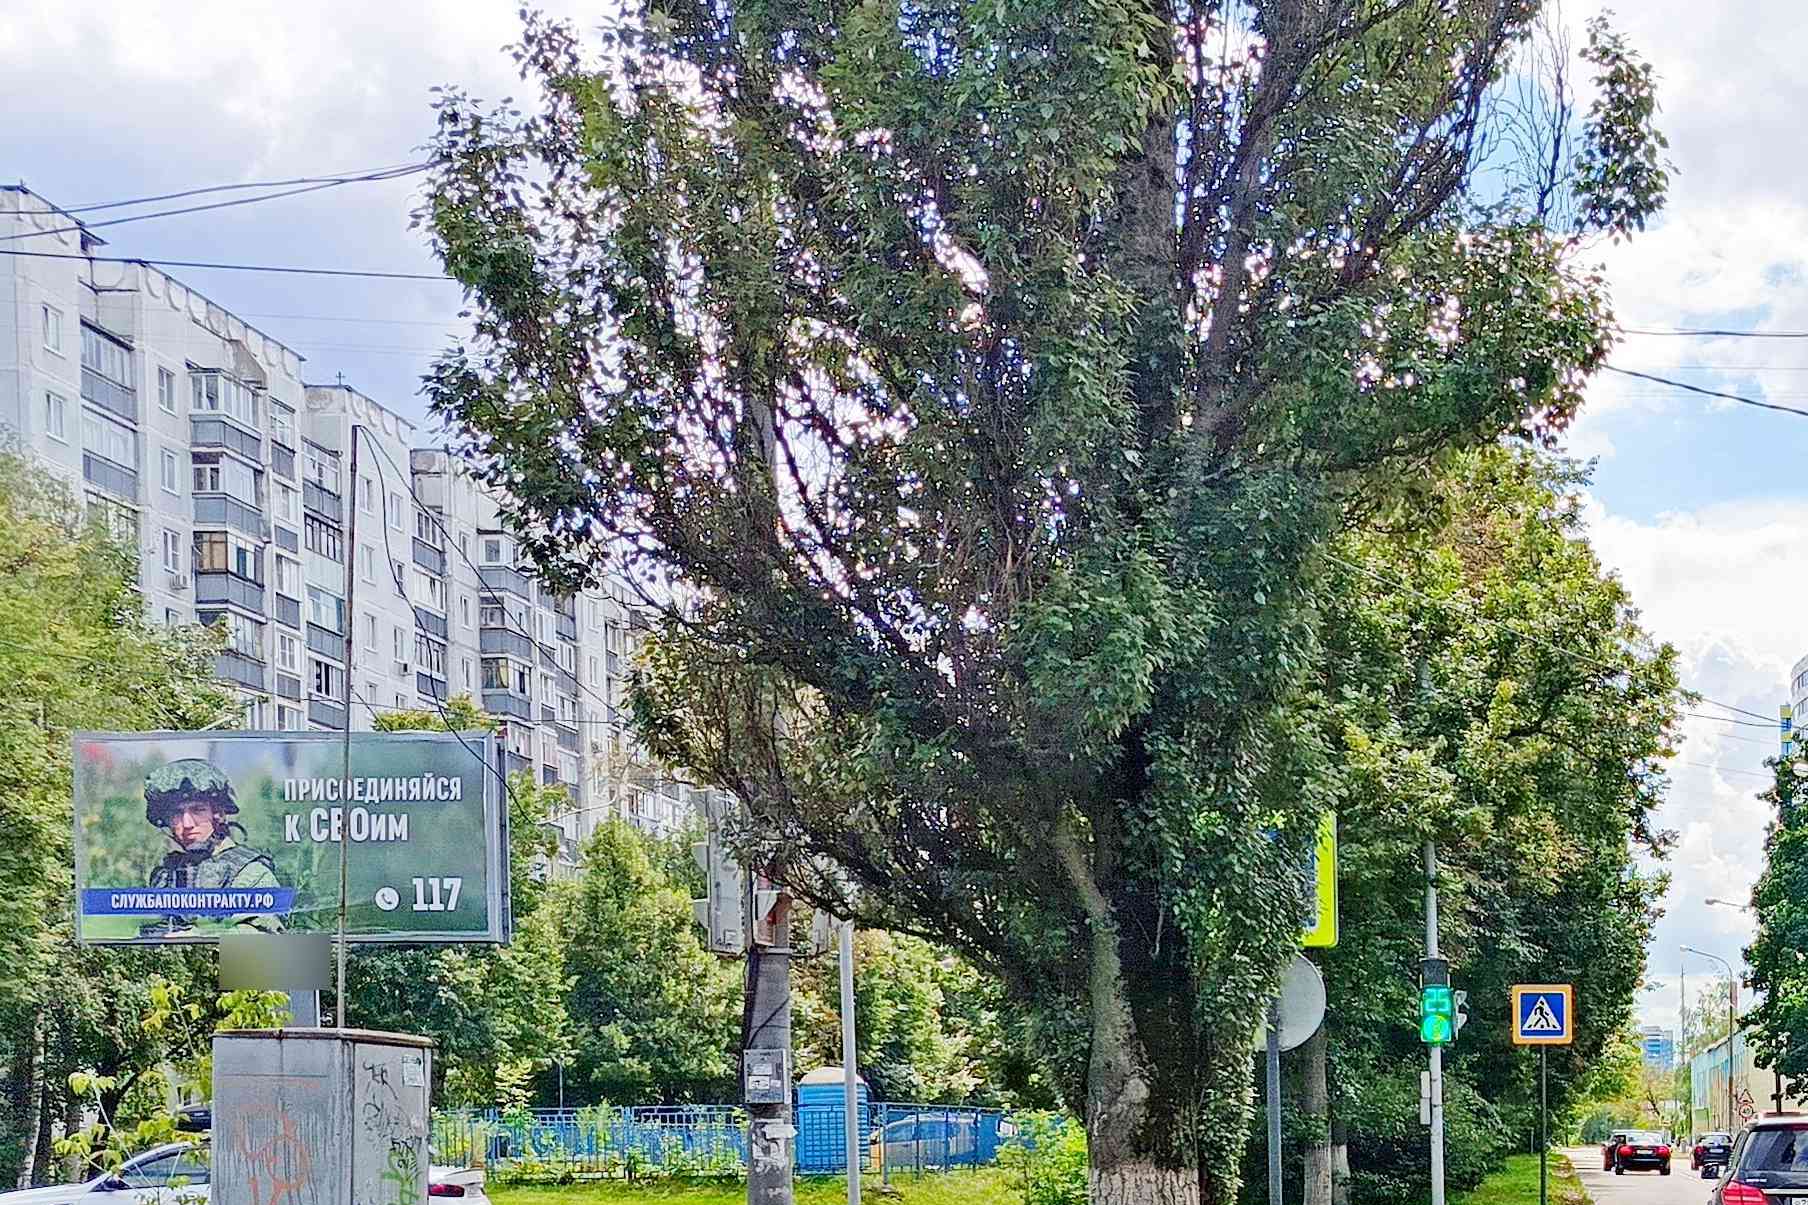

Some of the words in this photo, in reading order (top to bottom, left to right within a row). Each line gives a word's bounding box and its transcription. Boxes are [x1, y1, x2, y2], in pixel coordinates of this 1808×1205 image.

[284, 773, 463, 803] ПРИСОЕДИНЯЙСЯ
[111, 893, 274, 909] СЛУЖБАПОКОНТРАКТУ.РФ
[412, 877, 462, 911] 117
